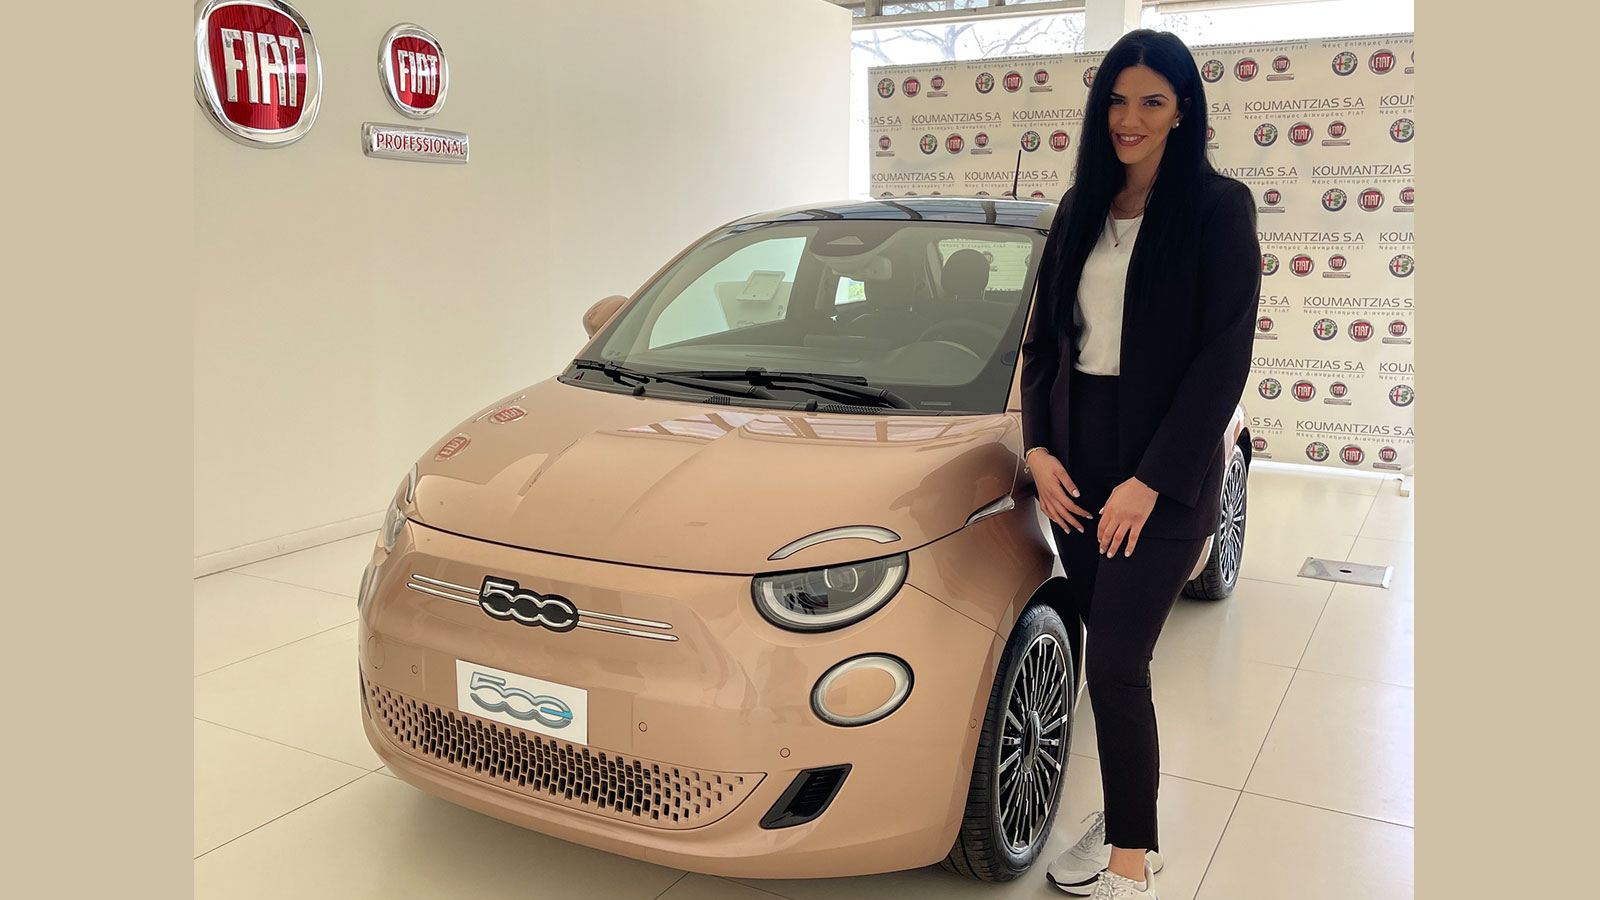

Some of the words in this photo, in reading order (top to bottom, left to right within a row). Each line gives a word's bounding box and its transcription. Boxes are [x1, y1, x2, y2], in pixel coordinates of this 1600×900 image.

[220, 27, 300, 107] FIAT
[1375, 56, 1391, 68] FIAT
[397, 49, 438, 95] FIAT
[1240, 65, 1254, 76] FIAT
[1212, 103, 1231, 112] S.A
[1245, 98, 1340, 112] KOUMANTZIAS
[1343, 97, 1364, 108] S.A
[912, 113, 983, 124] KOUMANTZIAS
[985, 112, 1002, 121] S.A
[1013, 109, 1085, 120] KOUMANTZIA
[887, 116, 902, 125] S.A
[1295, 129, 1309, 139] FIAT
[376, 133, 465, 156] PROFESSIONAL
[964, 171, 1039, 180] KOUMANTZIAS
[1041, 171, 1058, 179] S.A
[1217, 167, 1274, 177] ANTZIAS
[1277, 167, 1298, 176] S.A
[1312, 164, 1412, 176] KOUMANTZIAS
[872, 172, 937, 181] KOUMANTZIAS
[939, 172, 954, 180] S.A
[1364, 195, 1379, 206] FIAT
[1343, 232, 1364, 242] S.A
[1295, 260, 1310, 271] FIAT
[1270, 296, 1290, 305] S.A
[1304, 296, 1400, 308] KOUMANTZIAS
[1354, 326, 1369, 336] FIAT
[1251, 357, 1341, 370] KOUMANTZIAS
[1344, 361, 1365, 371] S.A
[1297, 387, 1311, 397] FIAT
[1250, 417, 1261, 426] S
[1264, 418, 1283, 428] S.A
[1296, 420, 1390, 435] KOUMANTZIAS
[1394, 426, 1414, 436] S.A
[1346, 450, 1360, 461] FIAT
[482, 581, 574, 628] 500
